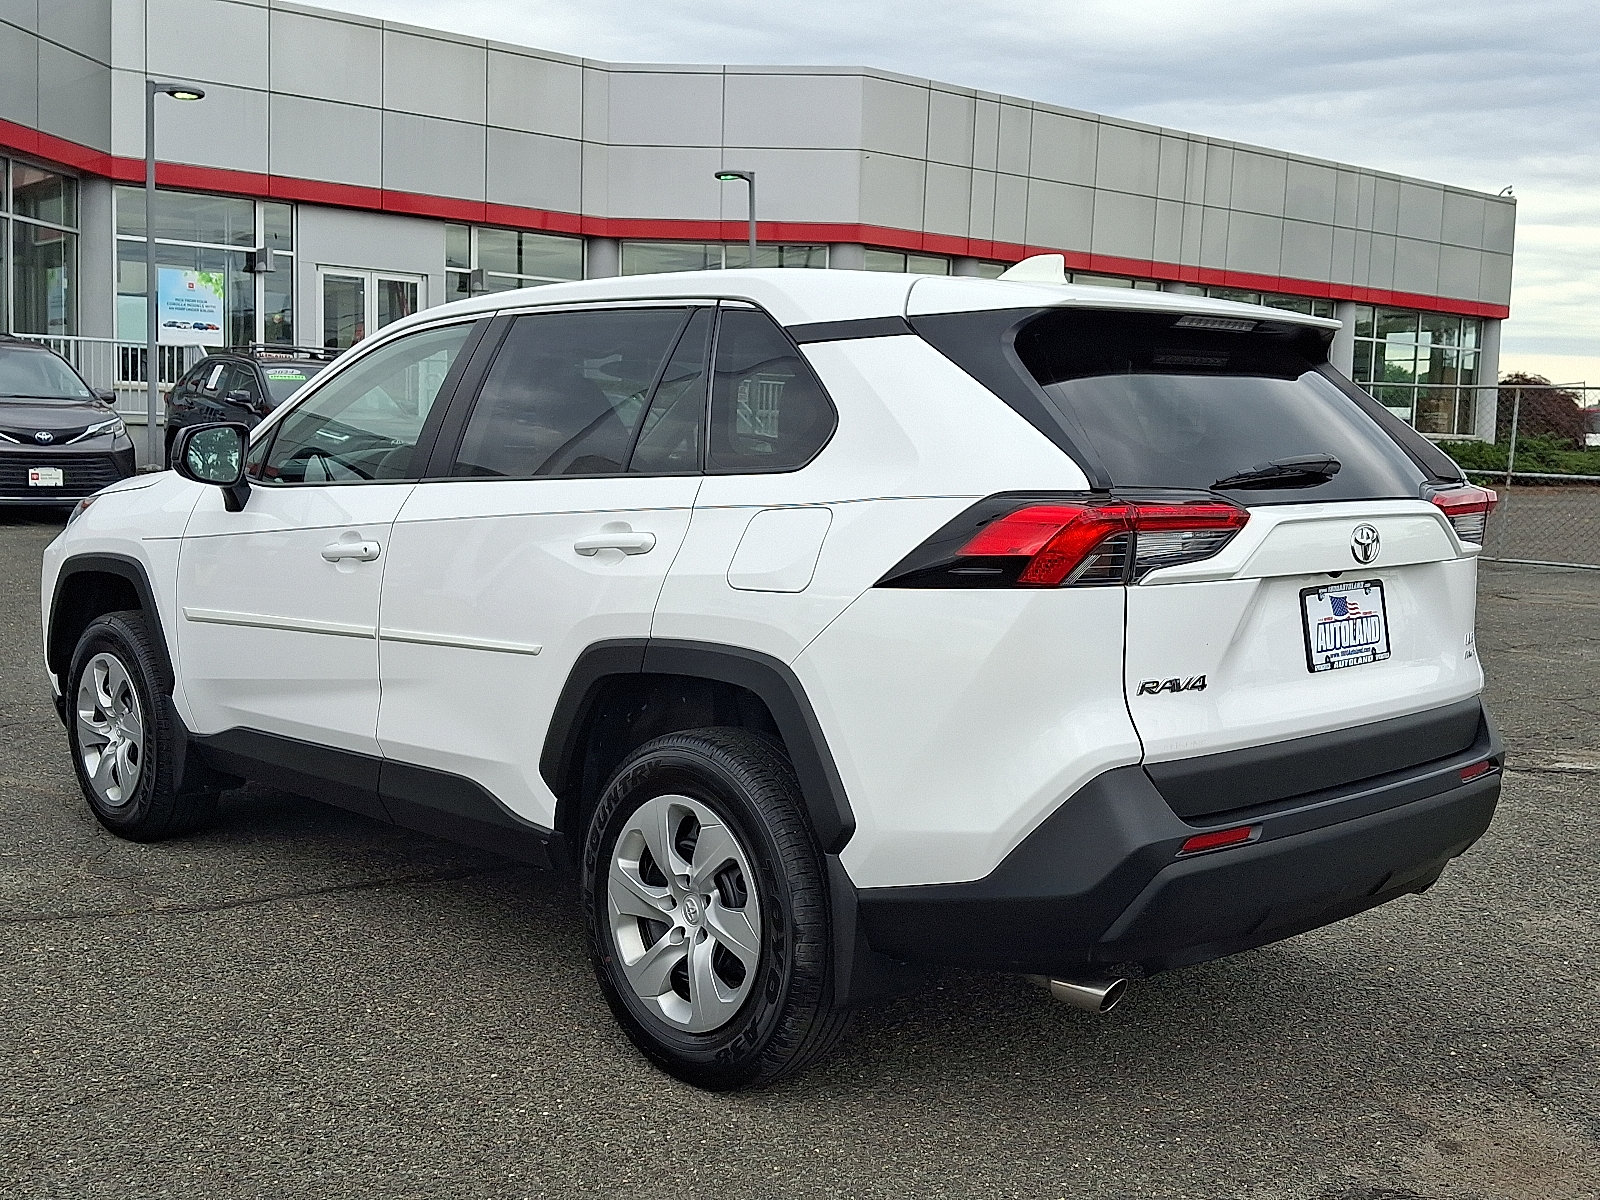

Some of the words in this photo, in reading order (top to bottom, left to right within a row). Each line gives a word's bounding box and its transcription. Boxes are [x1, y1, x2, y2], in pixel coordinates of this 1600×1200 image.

[1316, 615, 1381, 653] AUTOLAND
[1333, 656, 1374, 669] AUTOLAND
[1136, 674, 1207, 697] RAV4
